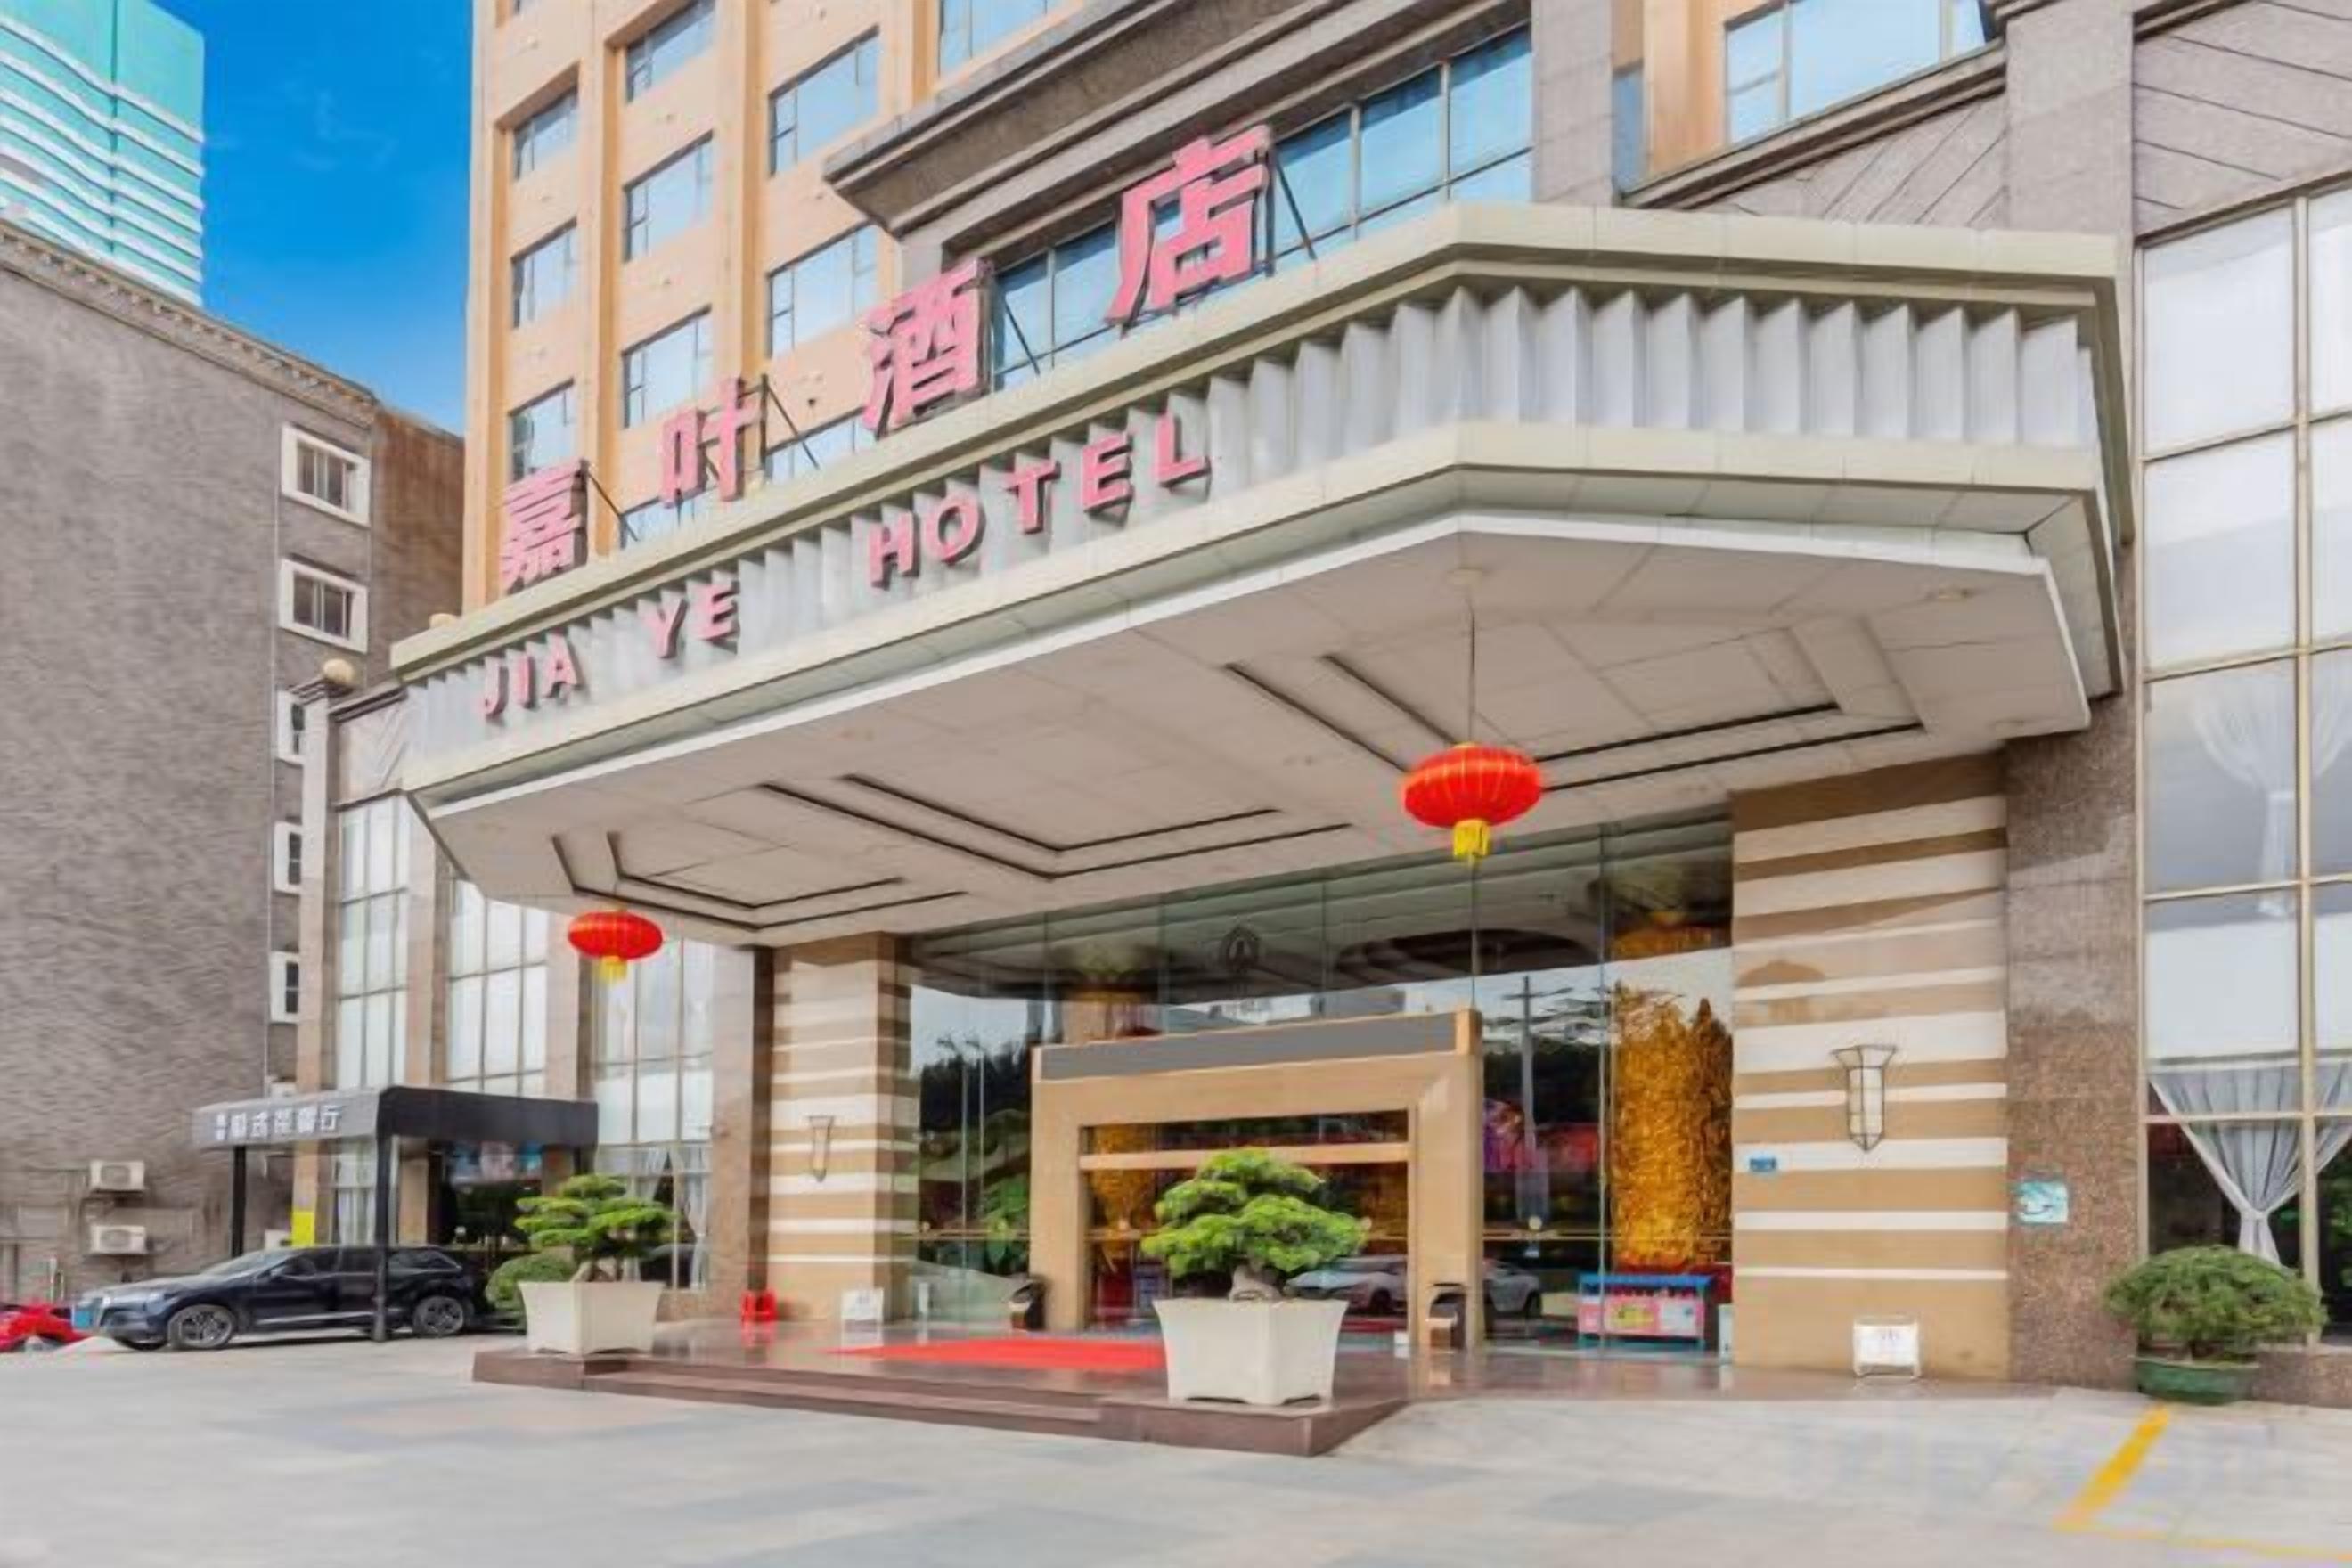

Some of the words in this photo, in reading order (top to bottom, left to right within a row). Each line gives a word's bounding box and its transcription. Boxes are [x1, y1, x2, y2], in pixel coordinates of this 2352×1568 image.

[500, 123, 1270, 592] 嘉叶酒店
[482, 629, 583, 716] JIA
[647, 582, 739, 659] YE
[869, 411, 1210, 589] HOTEL
